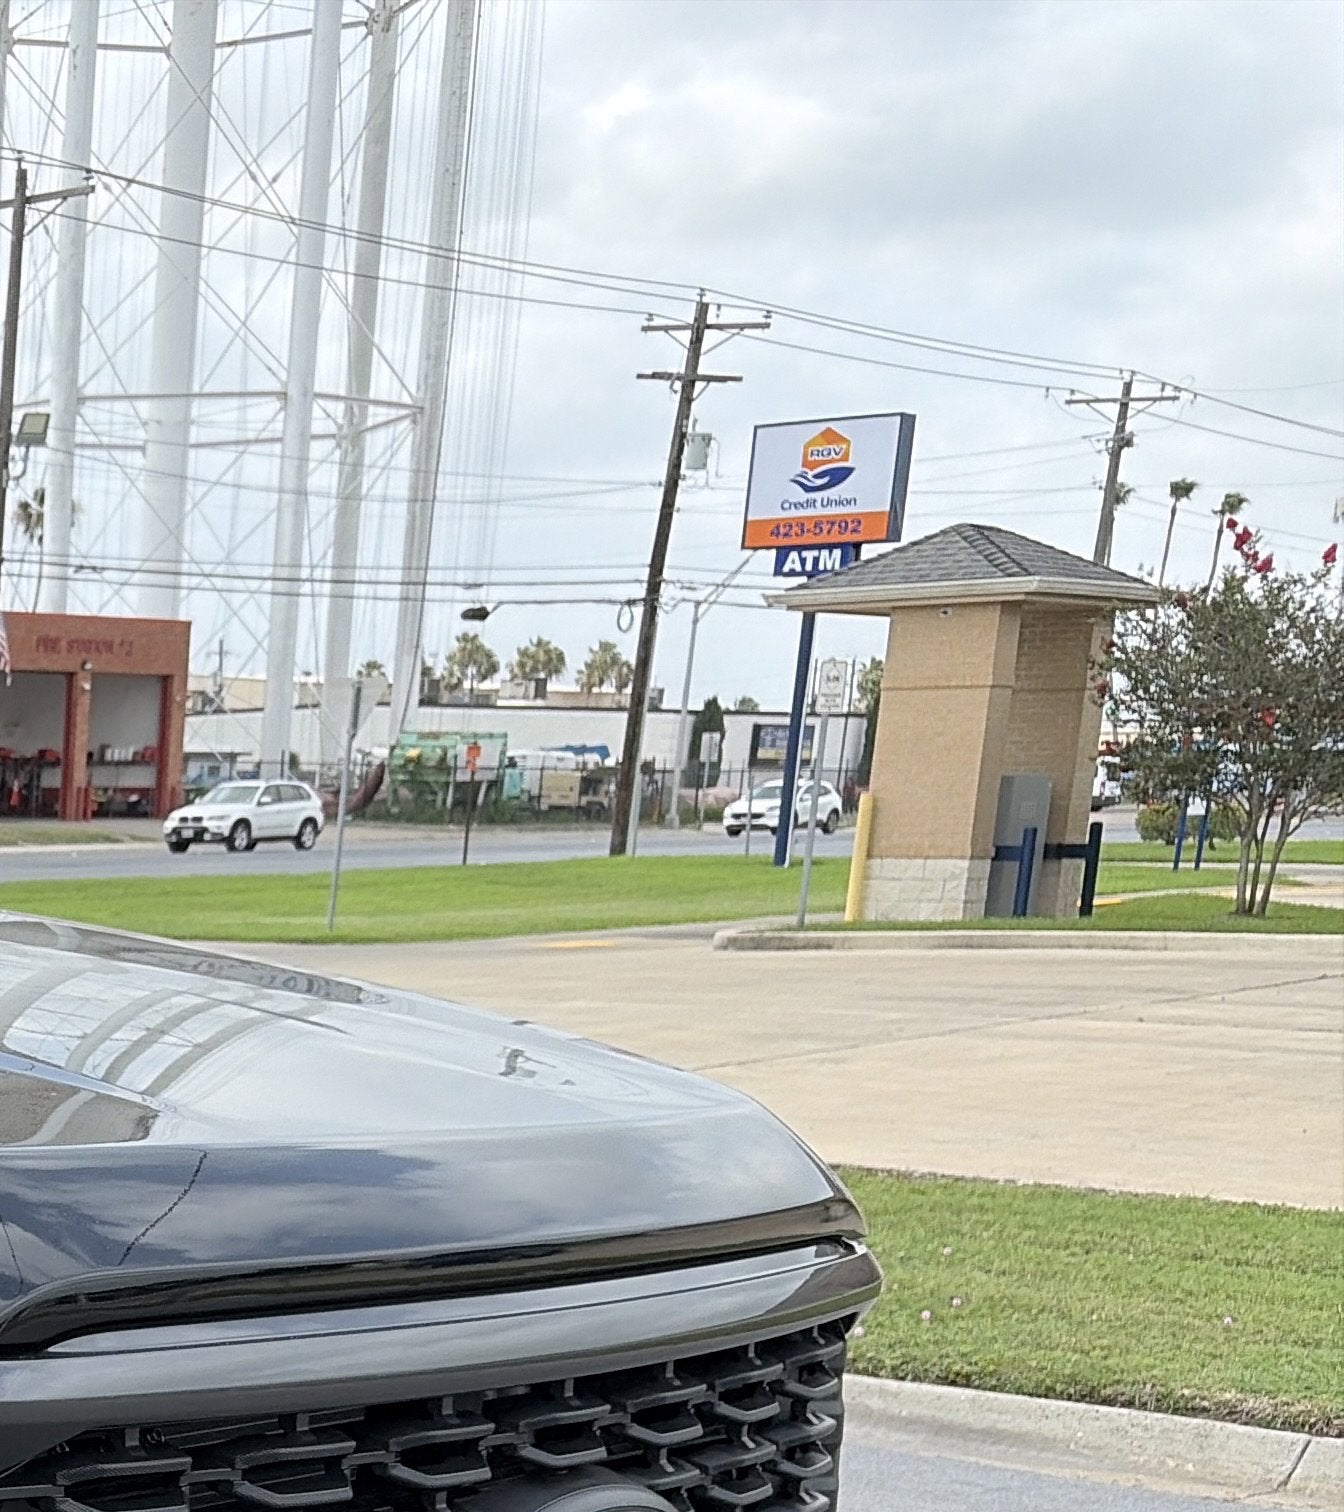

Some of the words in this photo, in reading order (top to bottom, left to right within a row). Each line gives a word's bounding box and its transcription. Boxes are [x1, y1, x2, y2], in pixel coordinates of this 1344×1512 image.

[780, 497, 817, 511] Credit
[820, 494, 858, 509] Union
[769, 518, 862, 540] 423-5792
[782, 548, 842, 573] ATM
